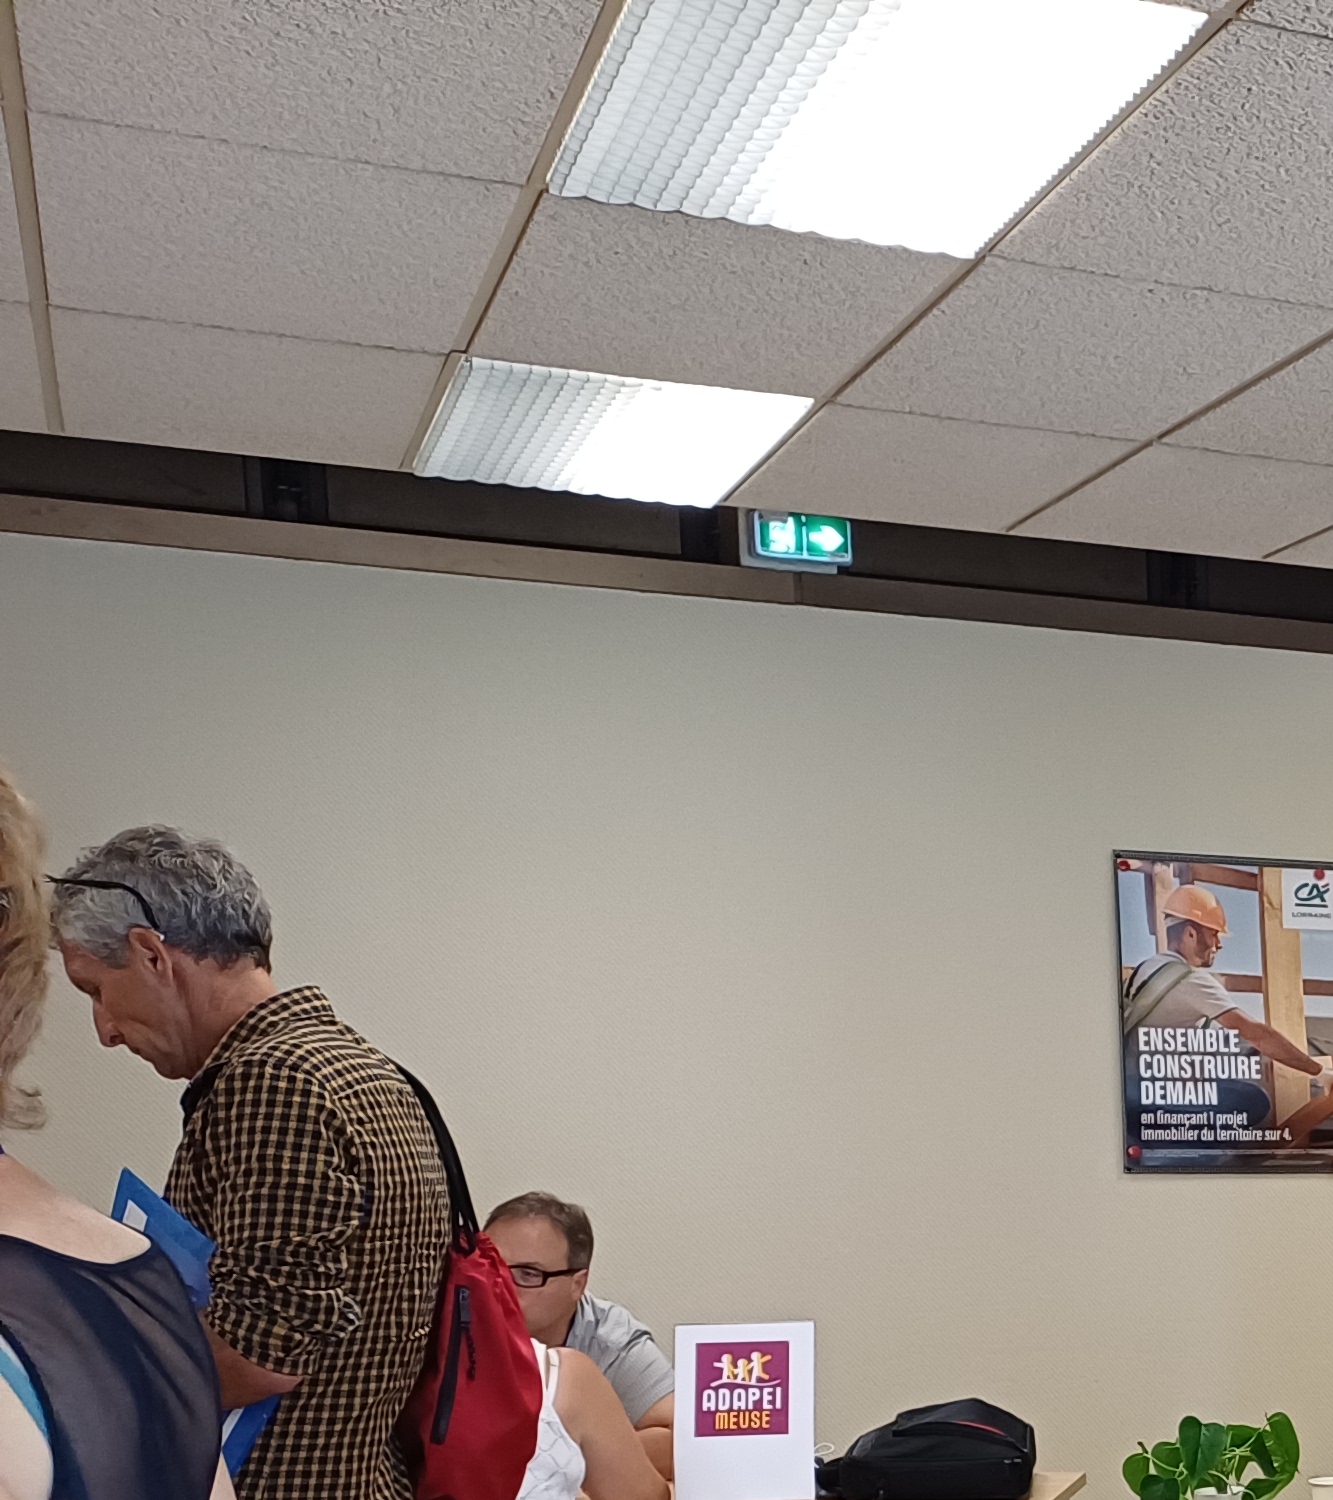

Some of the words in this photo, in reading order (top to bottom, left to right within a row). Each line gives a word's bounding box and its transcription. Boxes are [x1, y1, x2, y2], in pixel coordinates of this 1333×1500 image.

[1138, 1027, 1241, 1052] ENSEMBLE
[1139, 1054, 1262, 1080] CONSTRUIRE
[1140, 1081, 1218, 1106] DEMAIN
[1141, 1113, 1154, 1125] en
[1157, 1110, 1207, 1128] finançant
[1216, 1111, 1248, 1130] projet
[1141, 1127, 1199, 1141] immobilier
[1201, 1128, 1215, 1141] du
[1217, 1127, 1263, 1141] territoire
[1265, 1130, 1281, 1141] sur
[702, 1387, 782, 1412] ADAPEI
[715, 1411, 770, 1430] MEUSE
